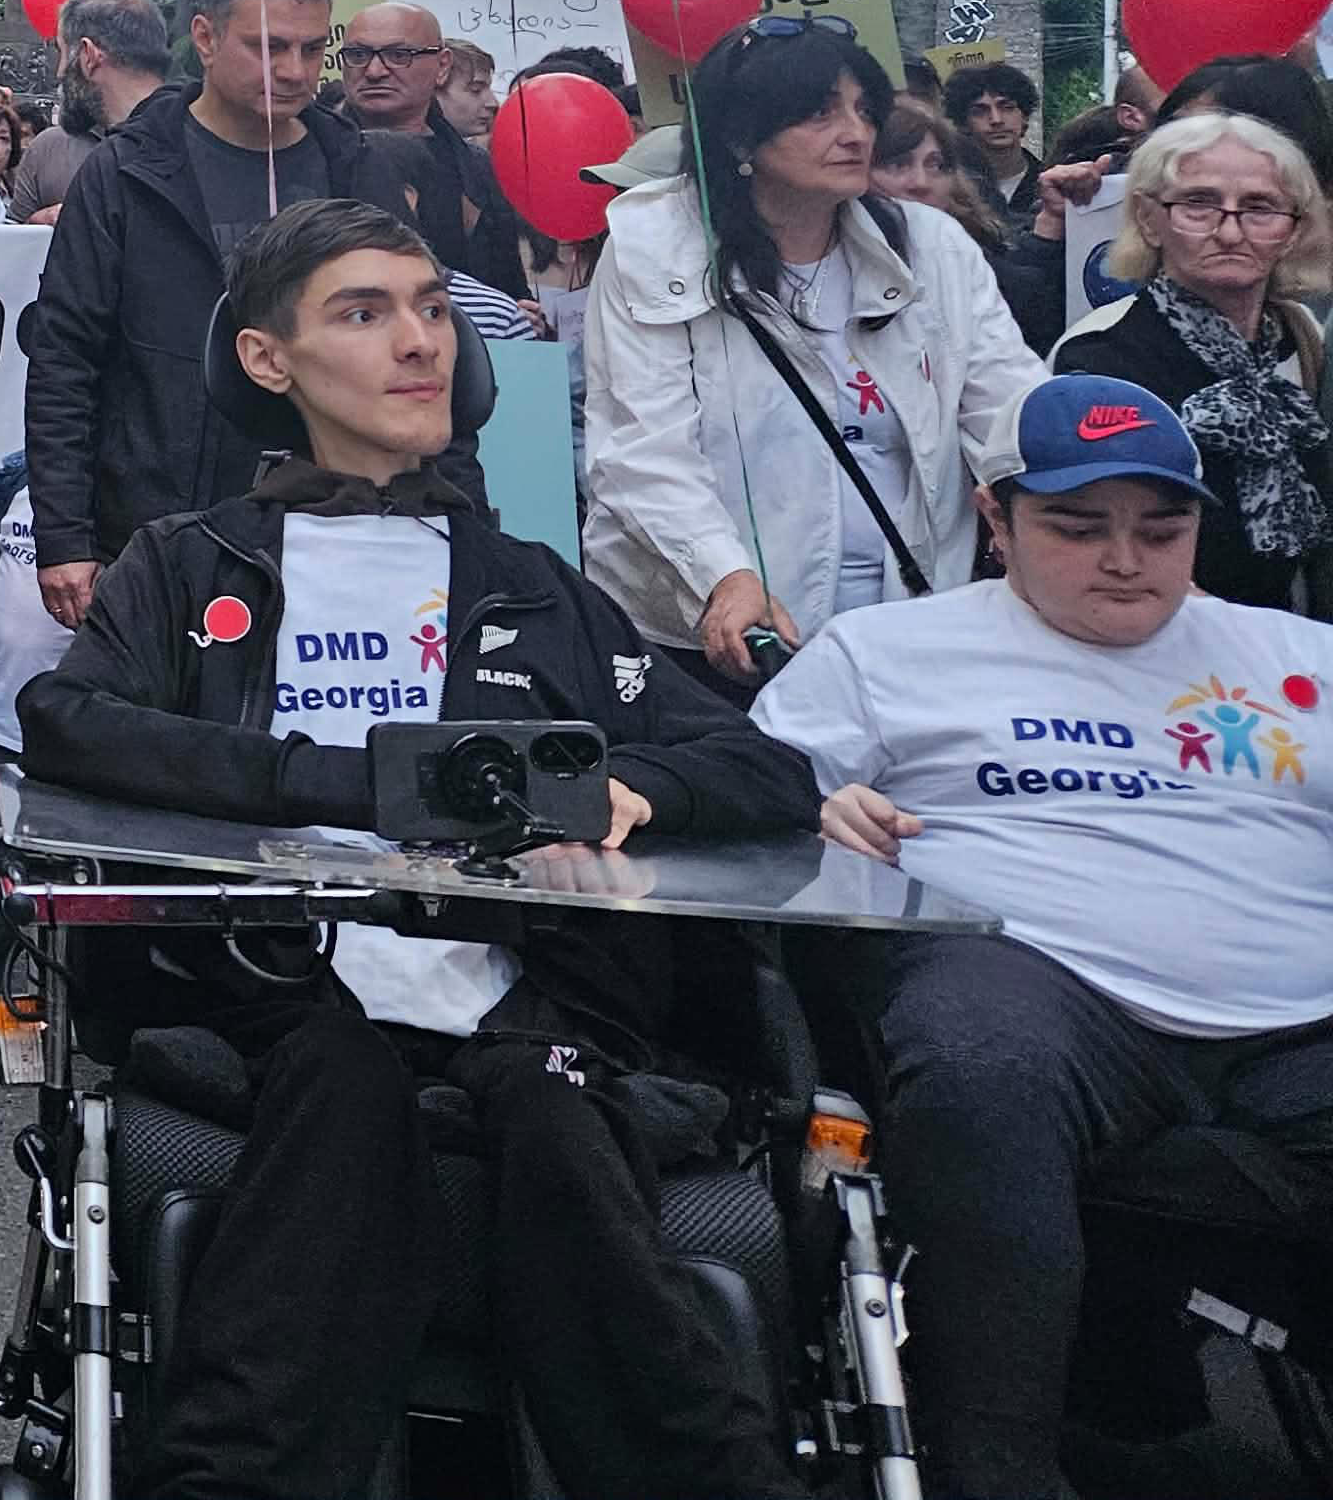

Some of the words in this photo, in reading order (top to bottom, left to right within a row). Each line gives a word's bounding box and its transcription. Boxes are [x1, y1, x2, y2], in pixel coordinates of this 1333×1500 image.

[1087, 405, 1141, 426] NIKE
[295, 631, 389, 664] DMD
[275, 679, 430, 717] Georgia
[1010, 717, 1134, 749] DMD
